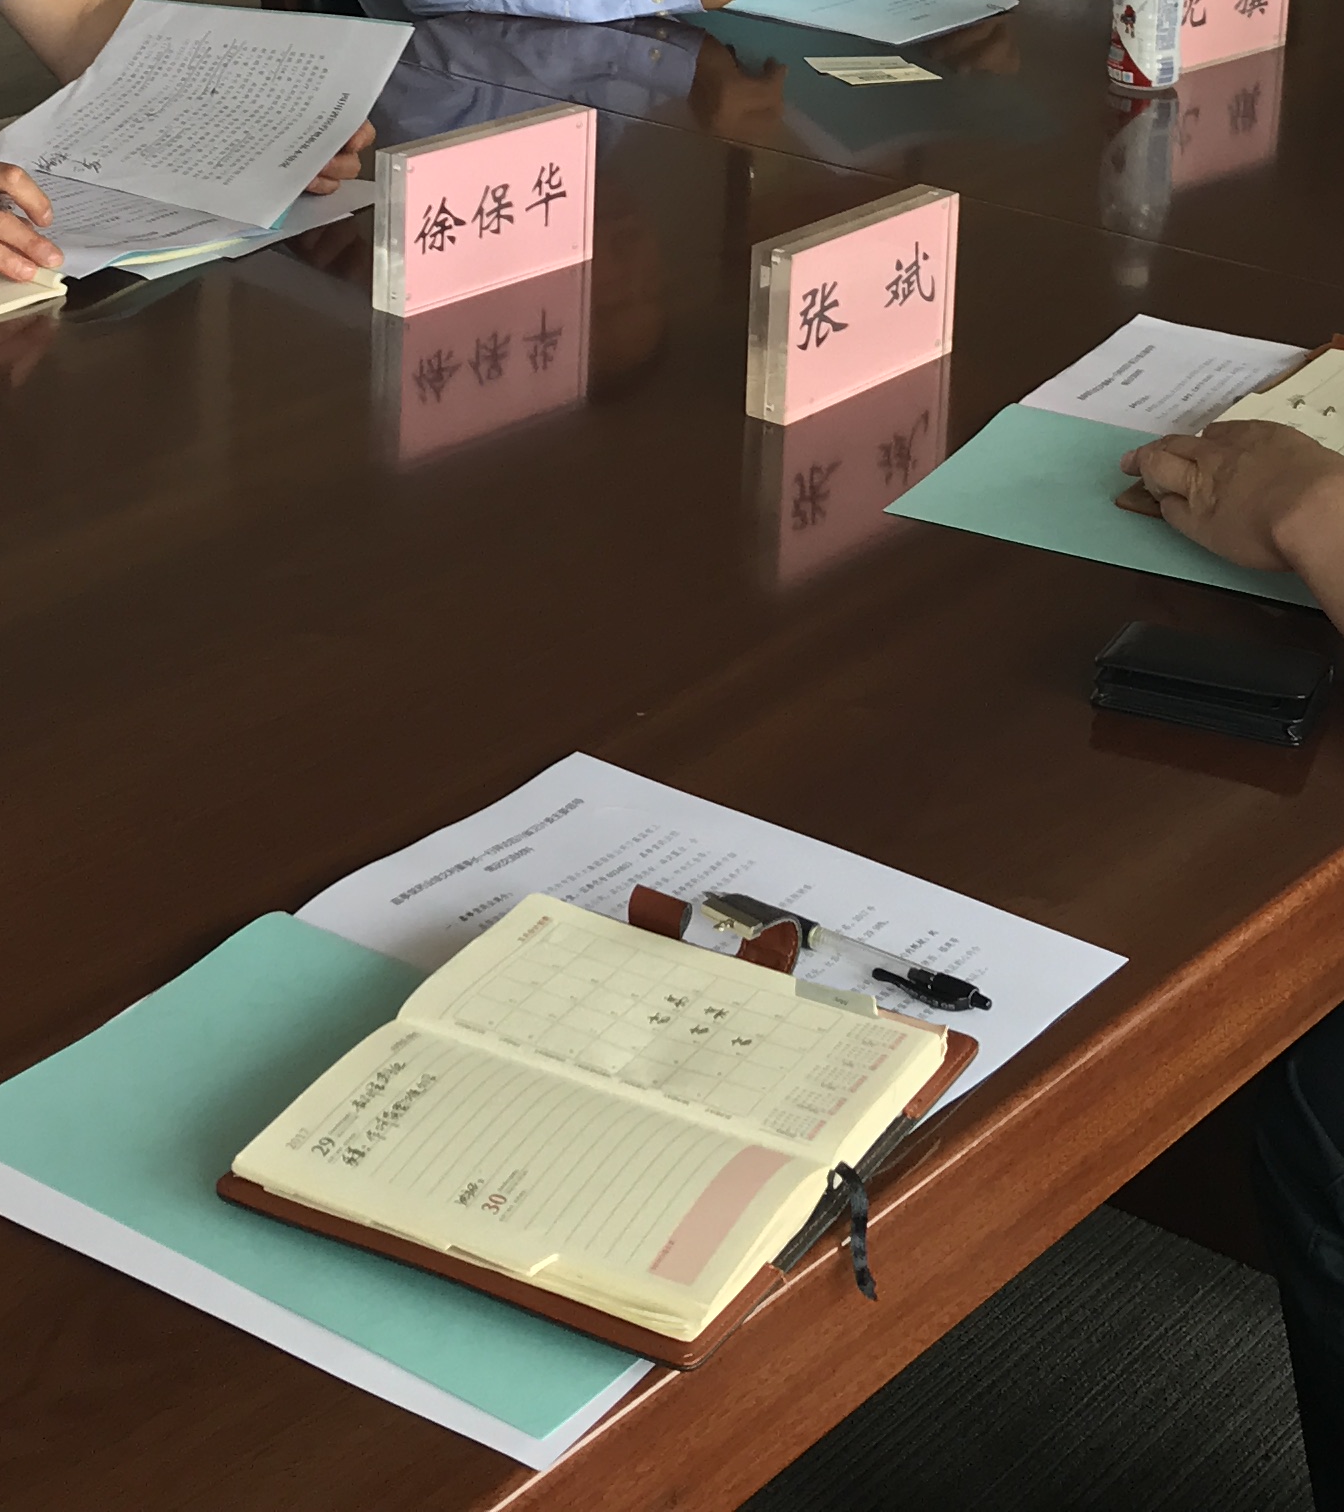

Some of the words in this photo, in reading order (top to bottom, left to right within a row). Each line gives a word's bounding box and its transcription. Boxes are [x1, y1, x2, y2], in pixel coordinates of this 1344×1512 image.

[414, 162, 567, 255] 徐保华
[311, 1136, 336, 1158] 29
[481, 1193, 508, 1216] 30
